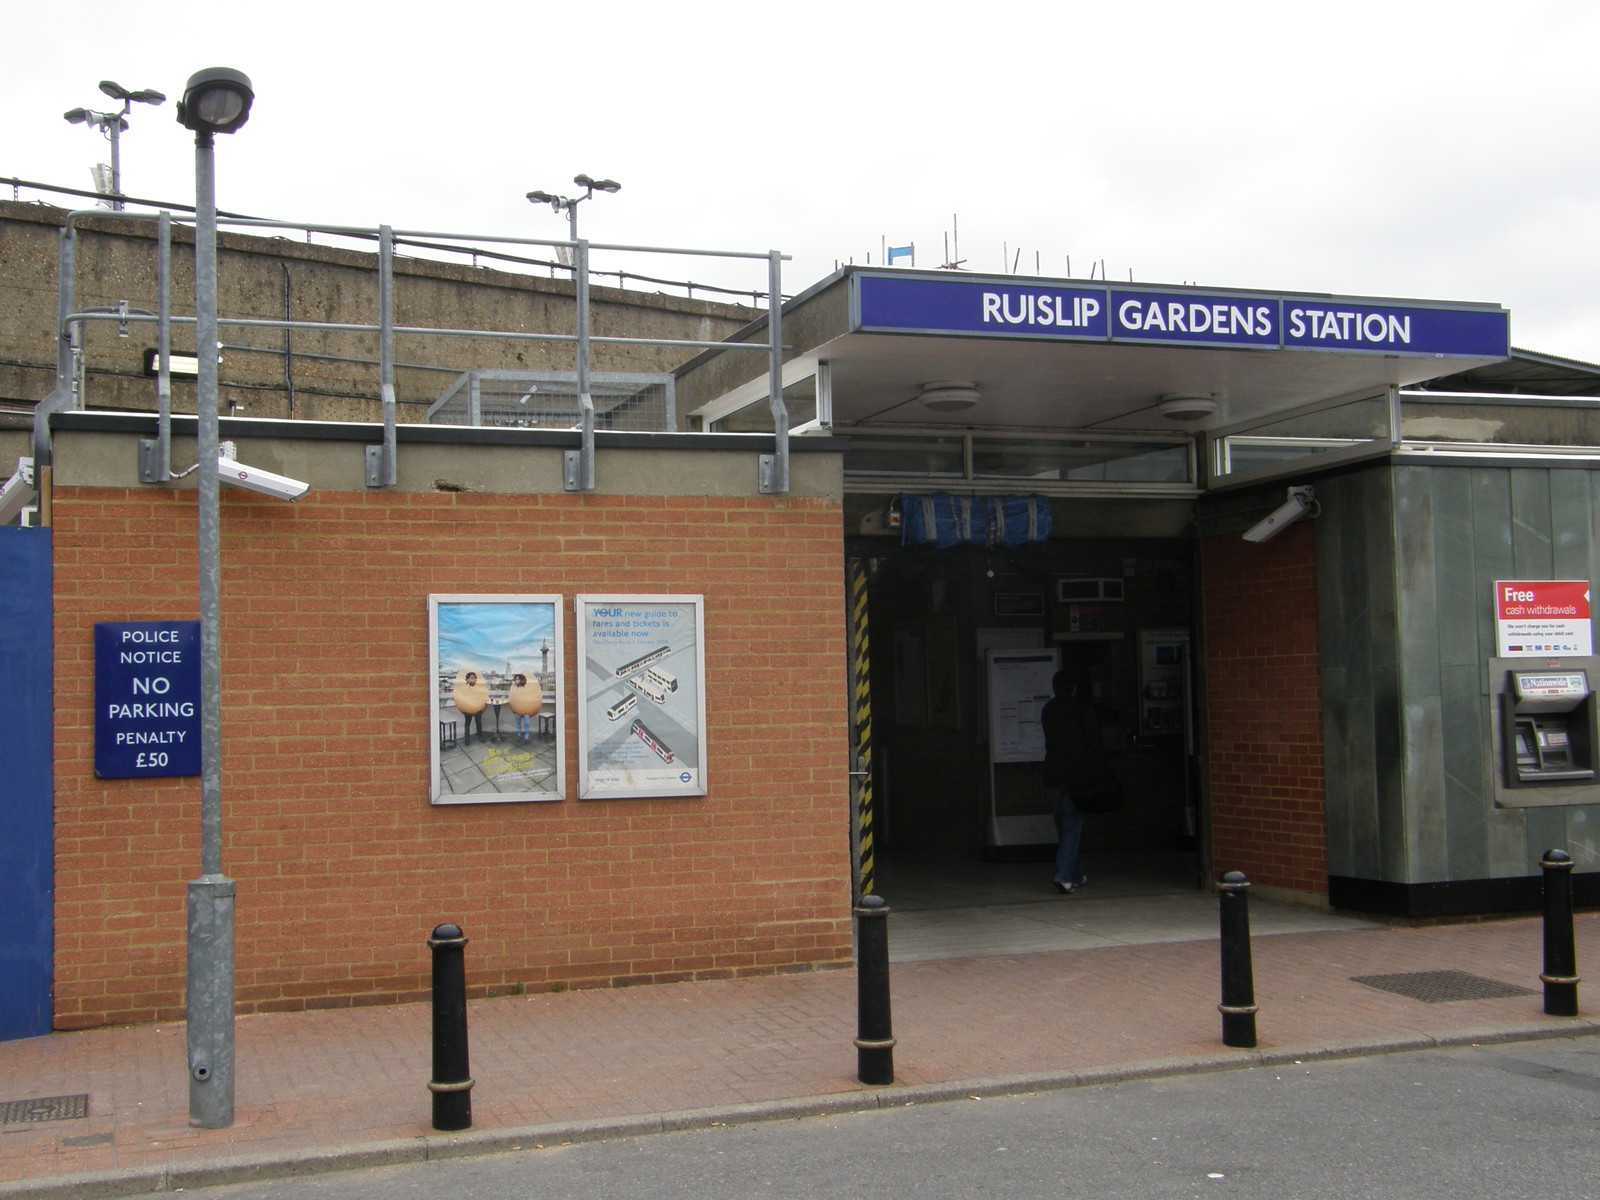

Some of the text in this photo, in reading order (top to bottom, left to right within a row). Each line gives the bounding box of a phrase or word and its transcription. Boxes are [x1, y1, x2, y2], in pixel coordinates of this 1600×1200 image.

[983, 292, 1410, 343] RUISLIP GARDENS STATION
[1504, 587, 1534, 602] Free
[593, 608, 622, 617] YOUR
[644, 609, 668, 619] guide
[1505, 605, 1576, 615] cash withdrawals
[122, 631, 179, 643] POLICE
[120, 651, 181, 664] NOTICE
[133, 677, 170, 695] NO
[1530, 678, 1567, 688] Nationwide
[109, 702, 194, 719] PARKING
[116, 731, 187, 745] PENALTY
[136, 752, 169, 768] £50
